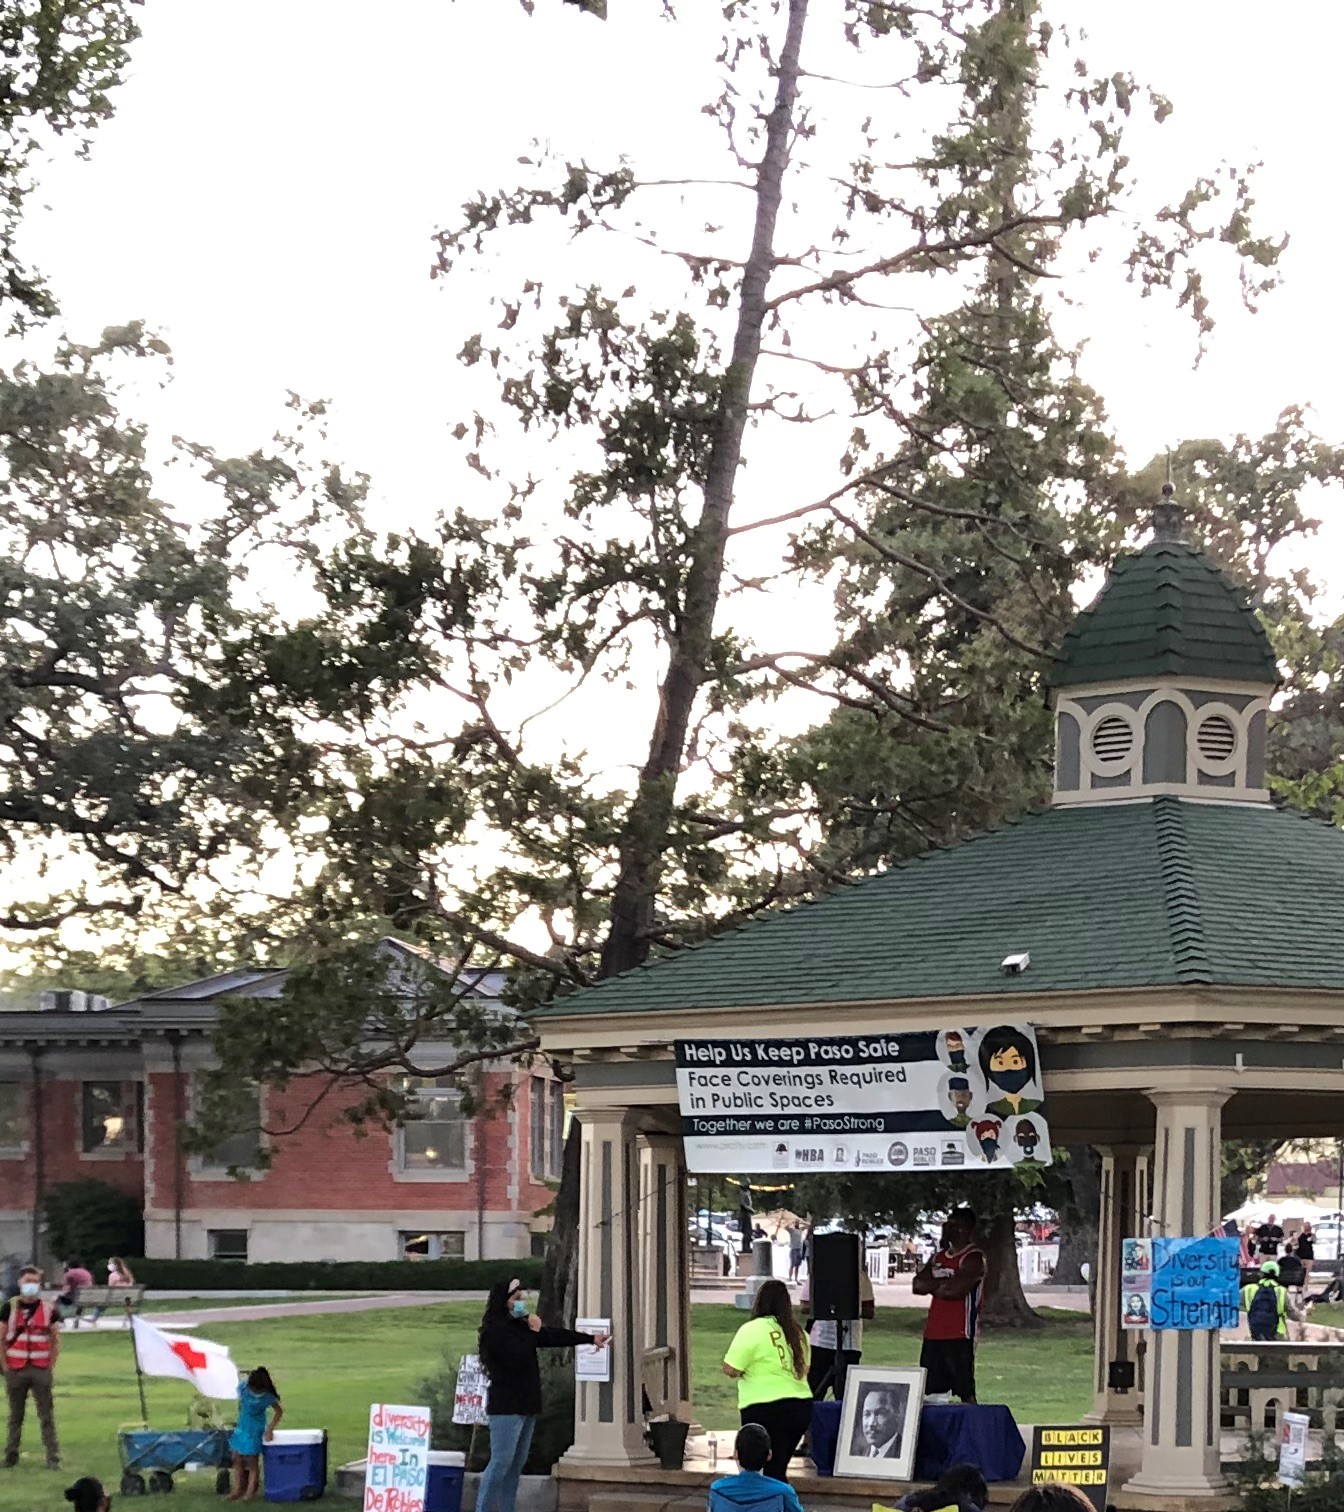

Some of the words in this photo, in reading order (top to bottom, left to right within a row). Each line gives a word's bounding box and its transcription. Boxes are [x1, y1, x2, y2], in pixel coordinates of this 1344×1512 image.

[684, 1044, 726, 1064] Help
[730, 1044, 752, 1060] Us
[755, 1044, 805, 1064] Keep
[808, 1042, 854, 1059] Paso
[858, 1039, 899, 1058] Safe
[688, 1071, 731, 1087] Face
[737, 1070, 823, 1089] Coverings
[828, 1066, 907, 1089] Required
[690, 1093, 706, 1109] in
[711, 1092, 764, 1109] Public
[769, 1092, 834, 1111] Spaces
[693, 1118, 752, 1134] Together
[755, 1120, 774, 1131] we
[778, 1119, 800, 1130] are
[805, 1116, 885, 1132] #PasoStrong
[1151, 1241, 1240, 1281] Diversity
[1150, 1288, 1240, 1329] Strength
[1043, 1431, 1101, 1443] BLACK
[1043, 1452, 1100, 1464] LIVES
[1033, 1470, 1104, 1482] MATTER
